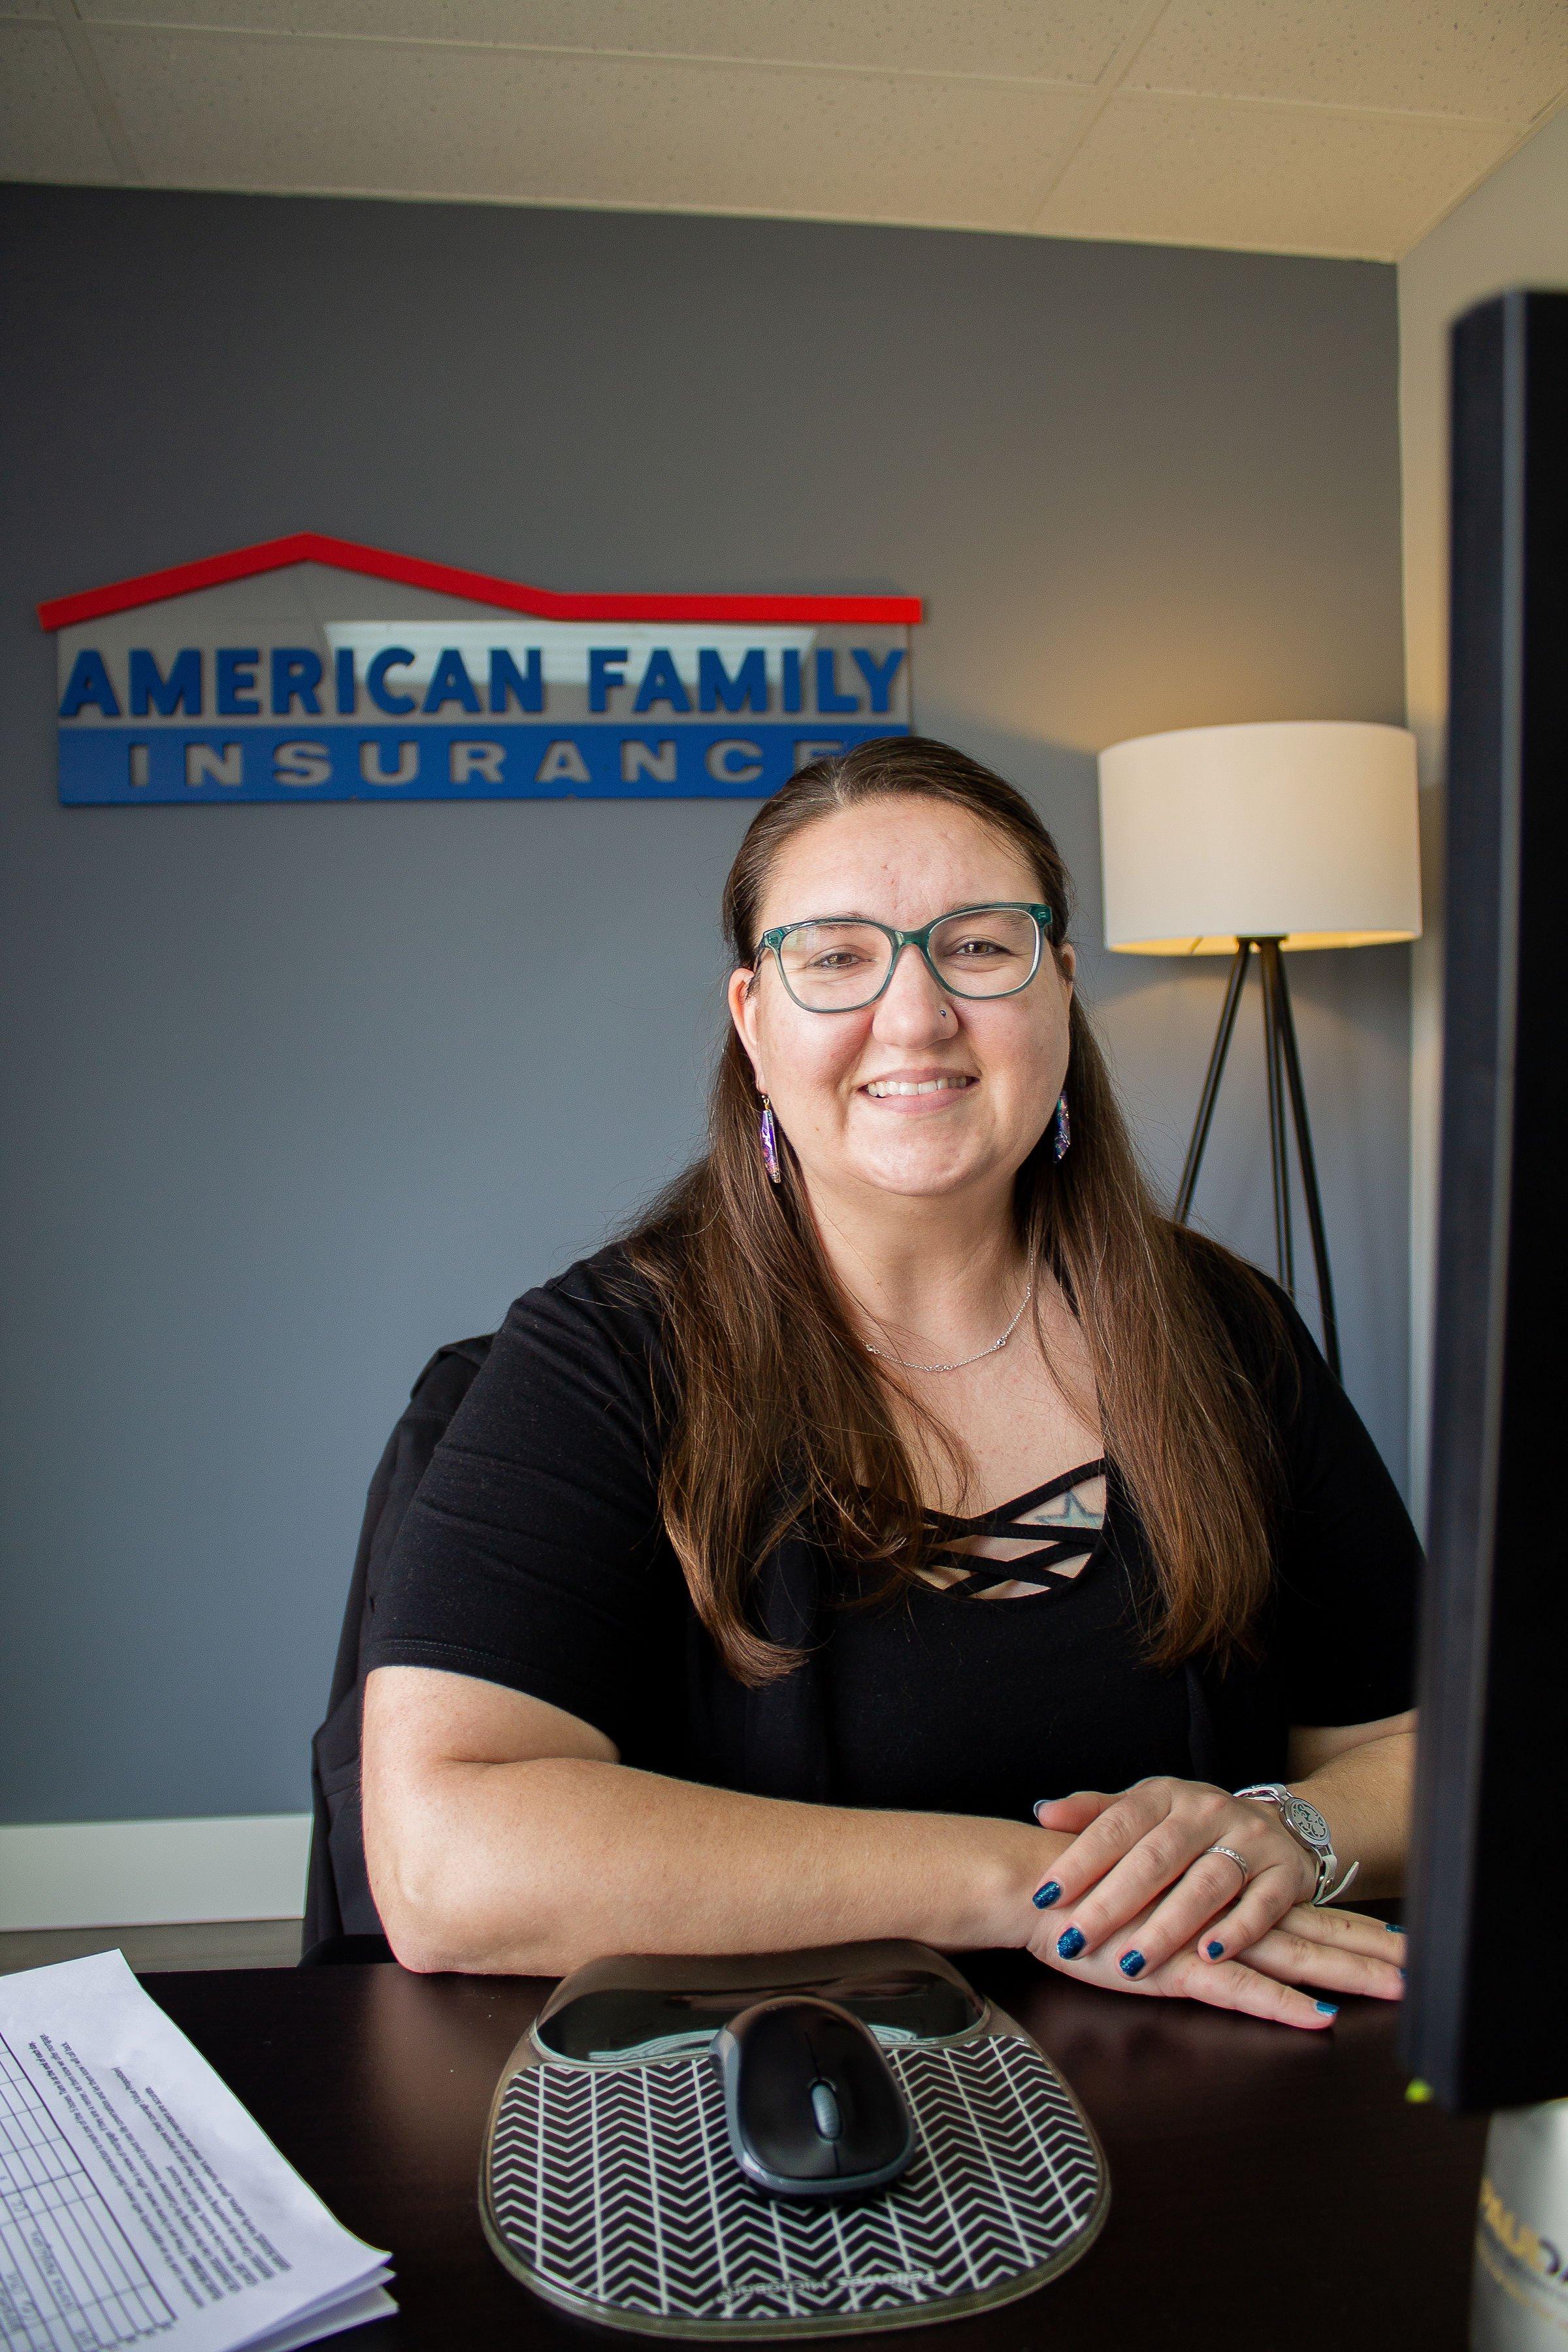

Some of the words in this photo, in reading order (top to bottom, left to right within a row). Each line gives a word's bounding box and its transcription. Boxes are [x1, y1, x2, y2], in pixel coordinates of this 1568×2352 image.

[58, 646, 545, 717] AMERICAN
[589, 647, 906, 714] FAMILY
[27, 2041, 38, 2051] day.
[31, 2049, 43, 2059] each
[65, 2051, 77, 2059] call
[39, 2062, 51, 2071] end
[46, 2069, 56, 2078] the
[56, 2084, 67, 2095] Turn
[838, 2268, 935, 2287] Fellowes
